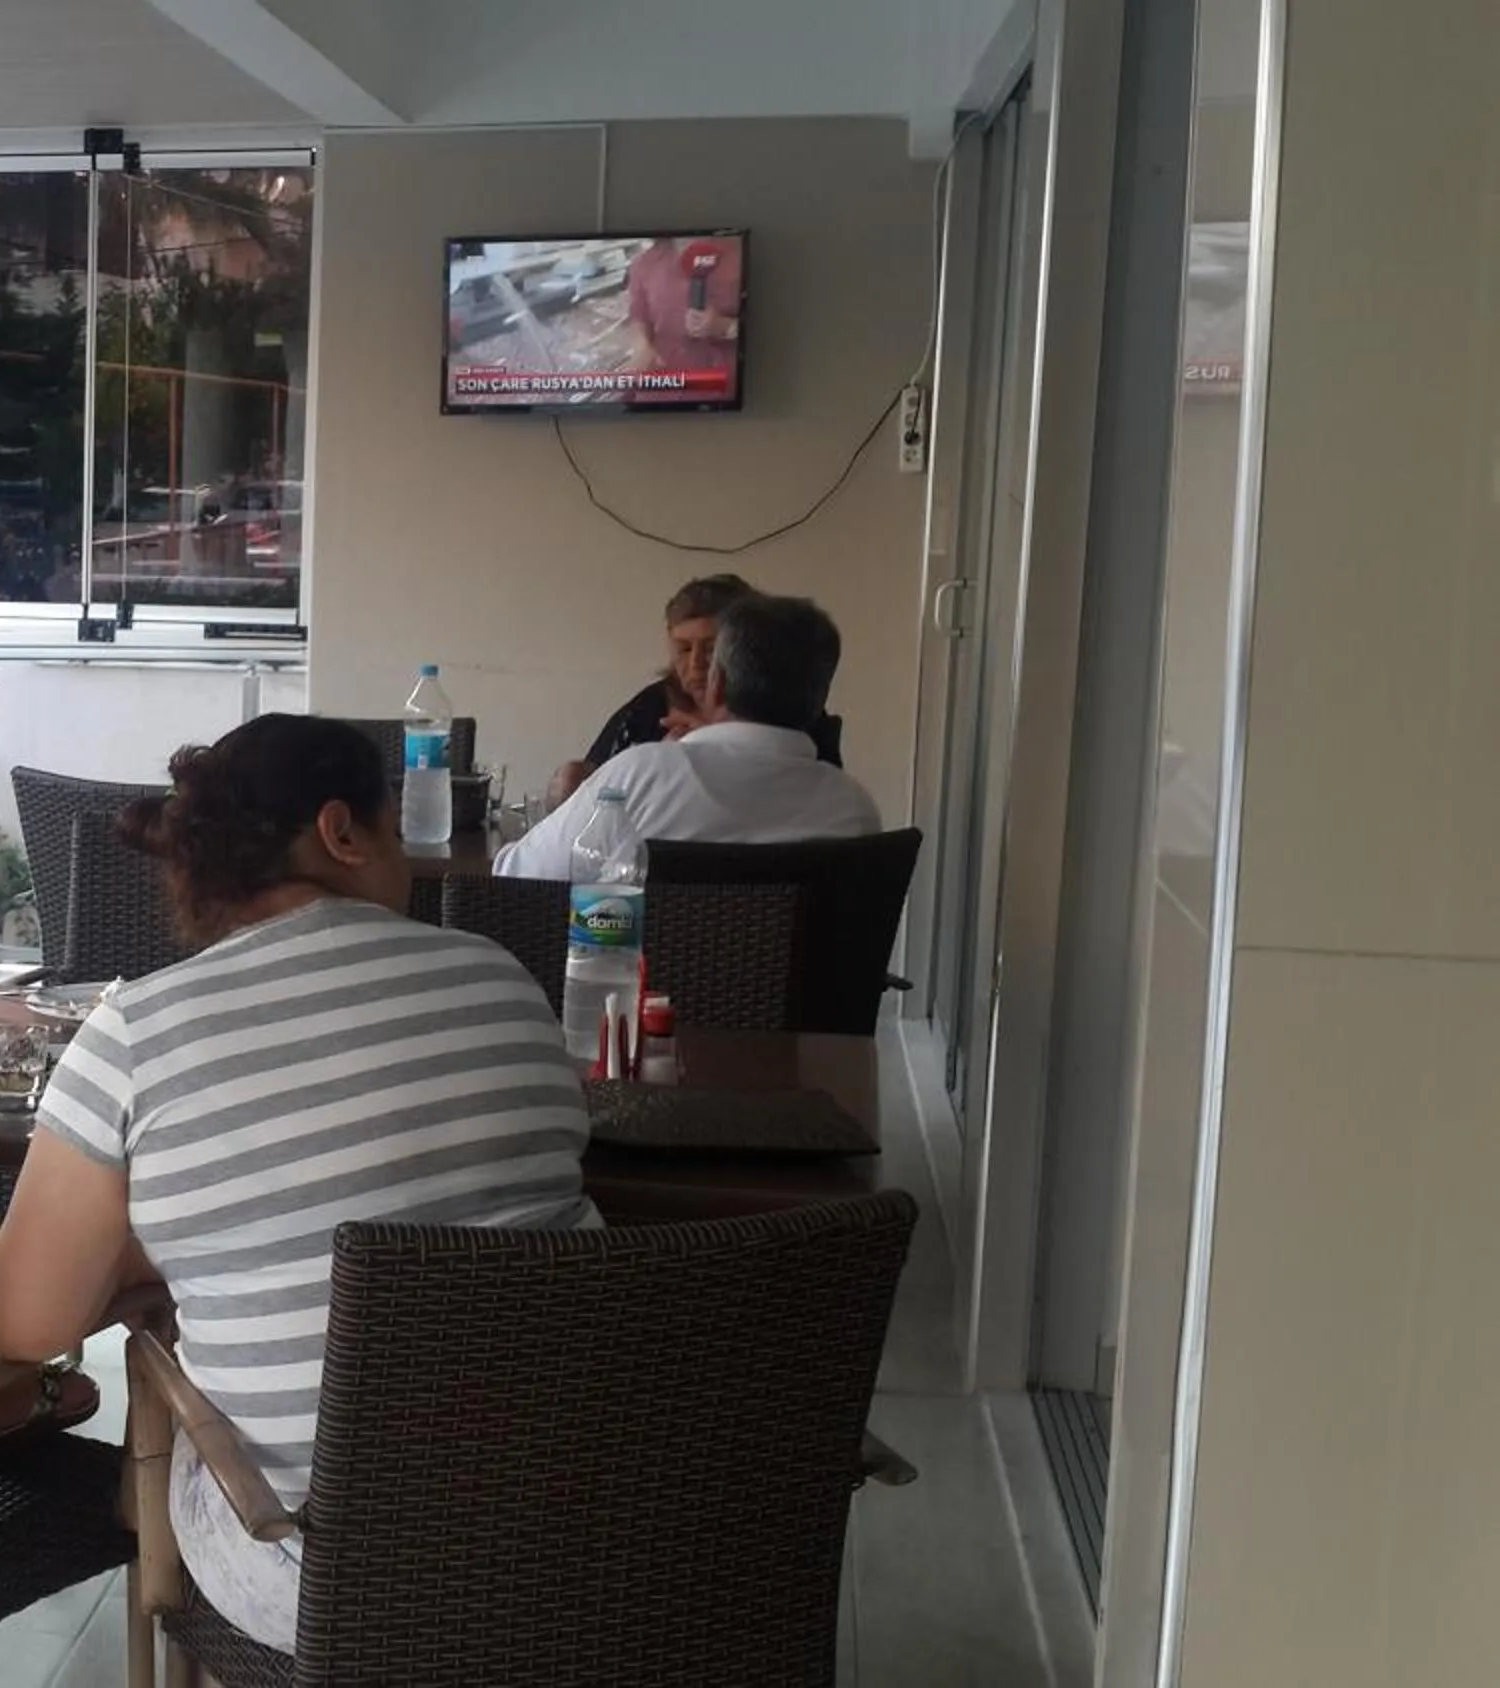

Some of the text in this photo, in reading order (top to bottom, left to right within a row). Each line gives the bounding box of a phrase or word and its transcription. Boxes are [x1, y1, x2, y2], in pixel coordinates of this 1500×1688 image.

[457, 378, 487, 391] SON
[491, 378, 529, 392] ÇARE
[531, 376, 613, 390] RUSYA'DAN
[617, 375, 635, 389] ET
